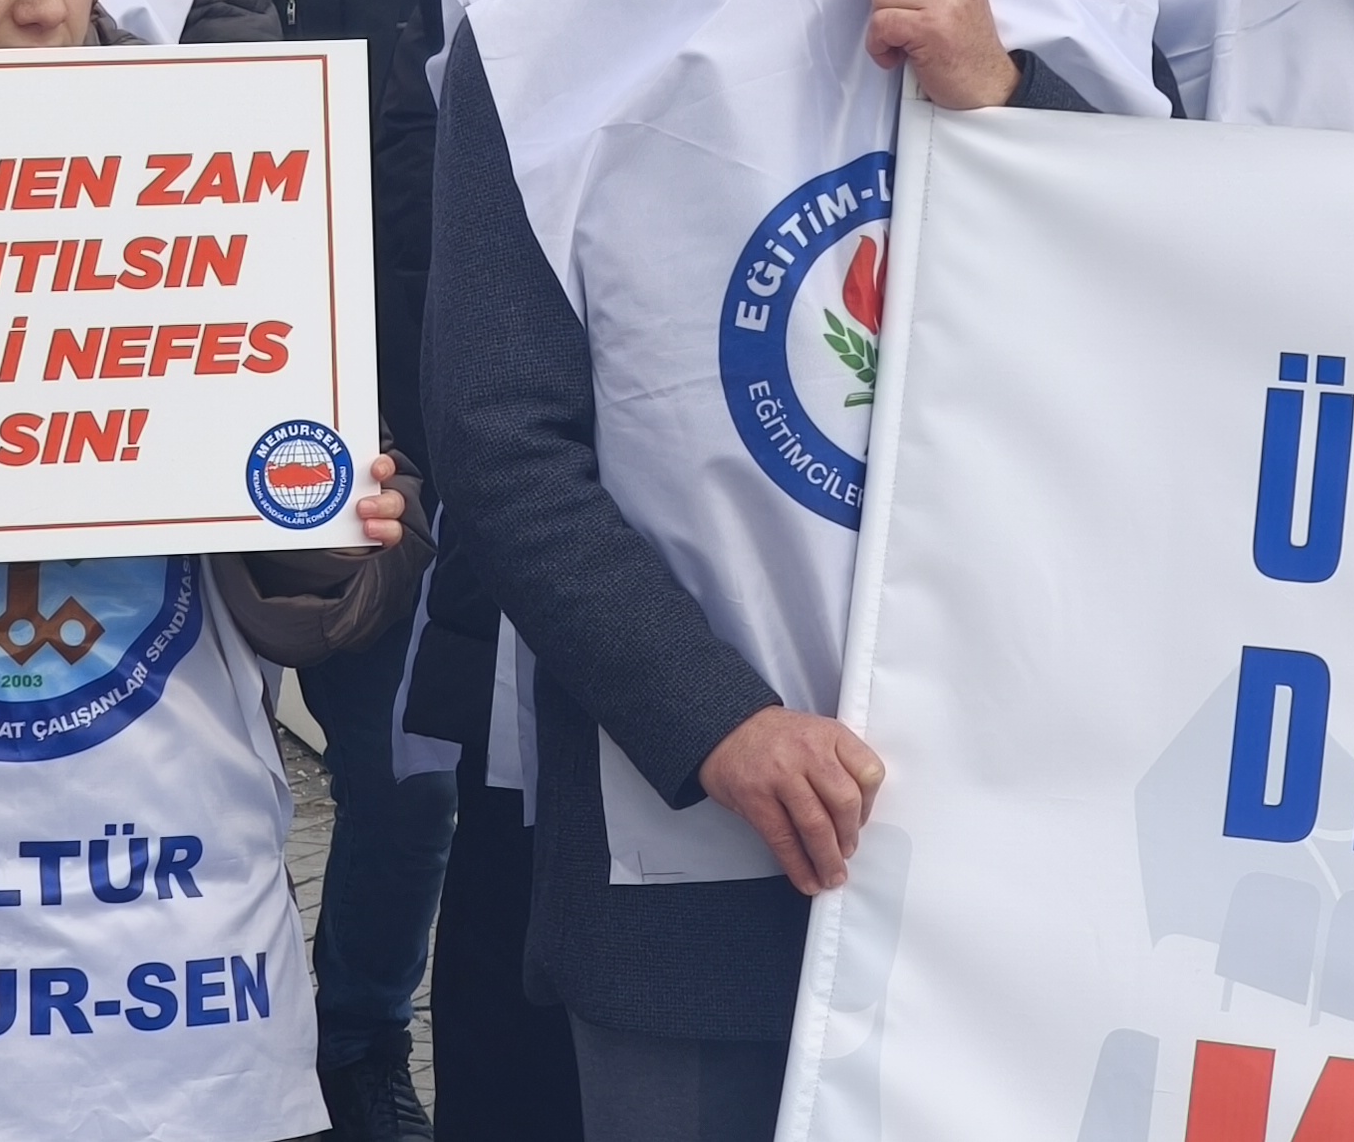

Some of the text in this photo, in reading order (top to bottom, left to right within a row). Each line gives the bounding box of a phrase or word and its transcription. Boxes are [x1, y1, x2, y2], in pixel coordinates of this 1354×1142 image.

[136, 150, 309, 206] ZAM
[43, 321, 293, 380] NEFES
[256, 424, 342, 458] MEMUR-SEN
[0, 674, 43, 688] 2003
[32, 663, 148, 741] ÇALIŞANLARI
